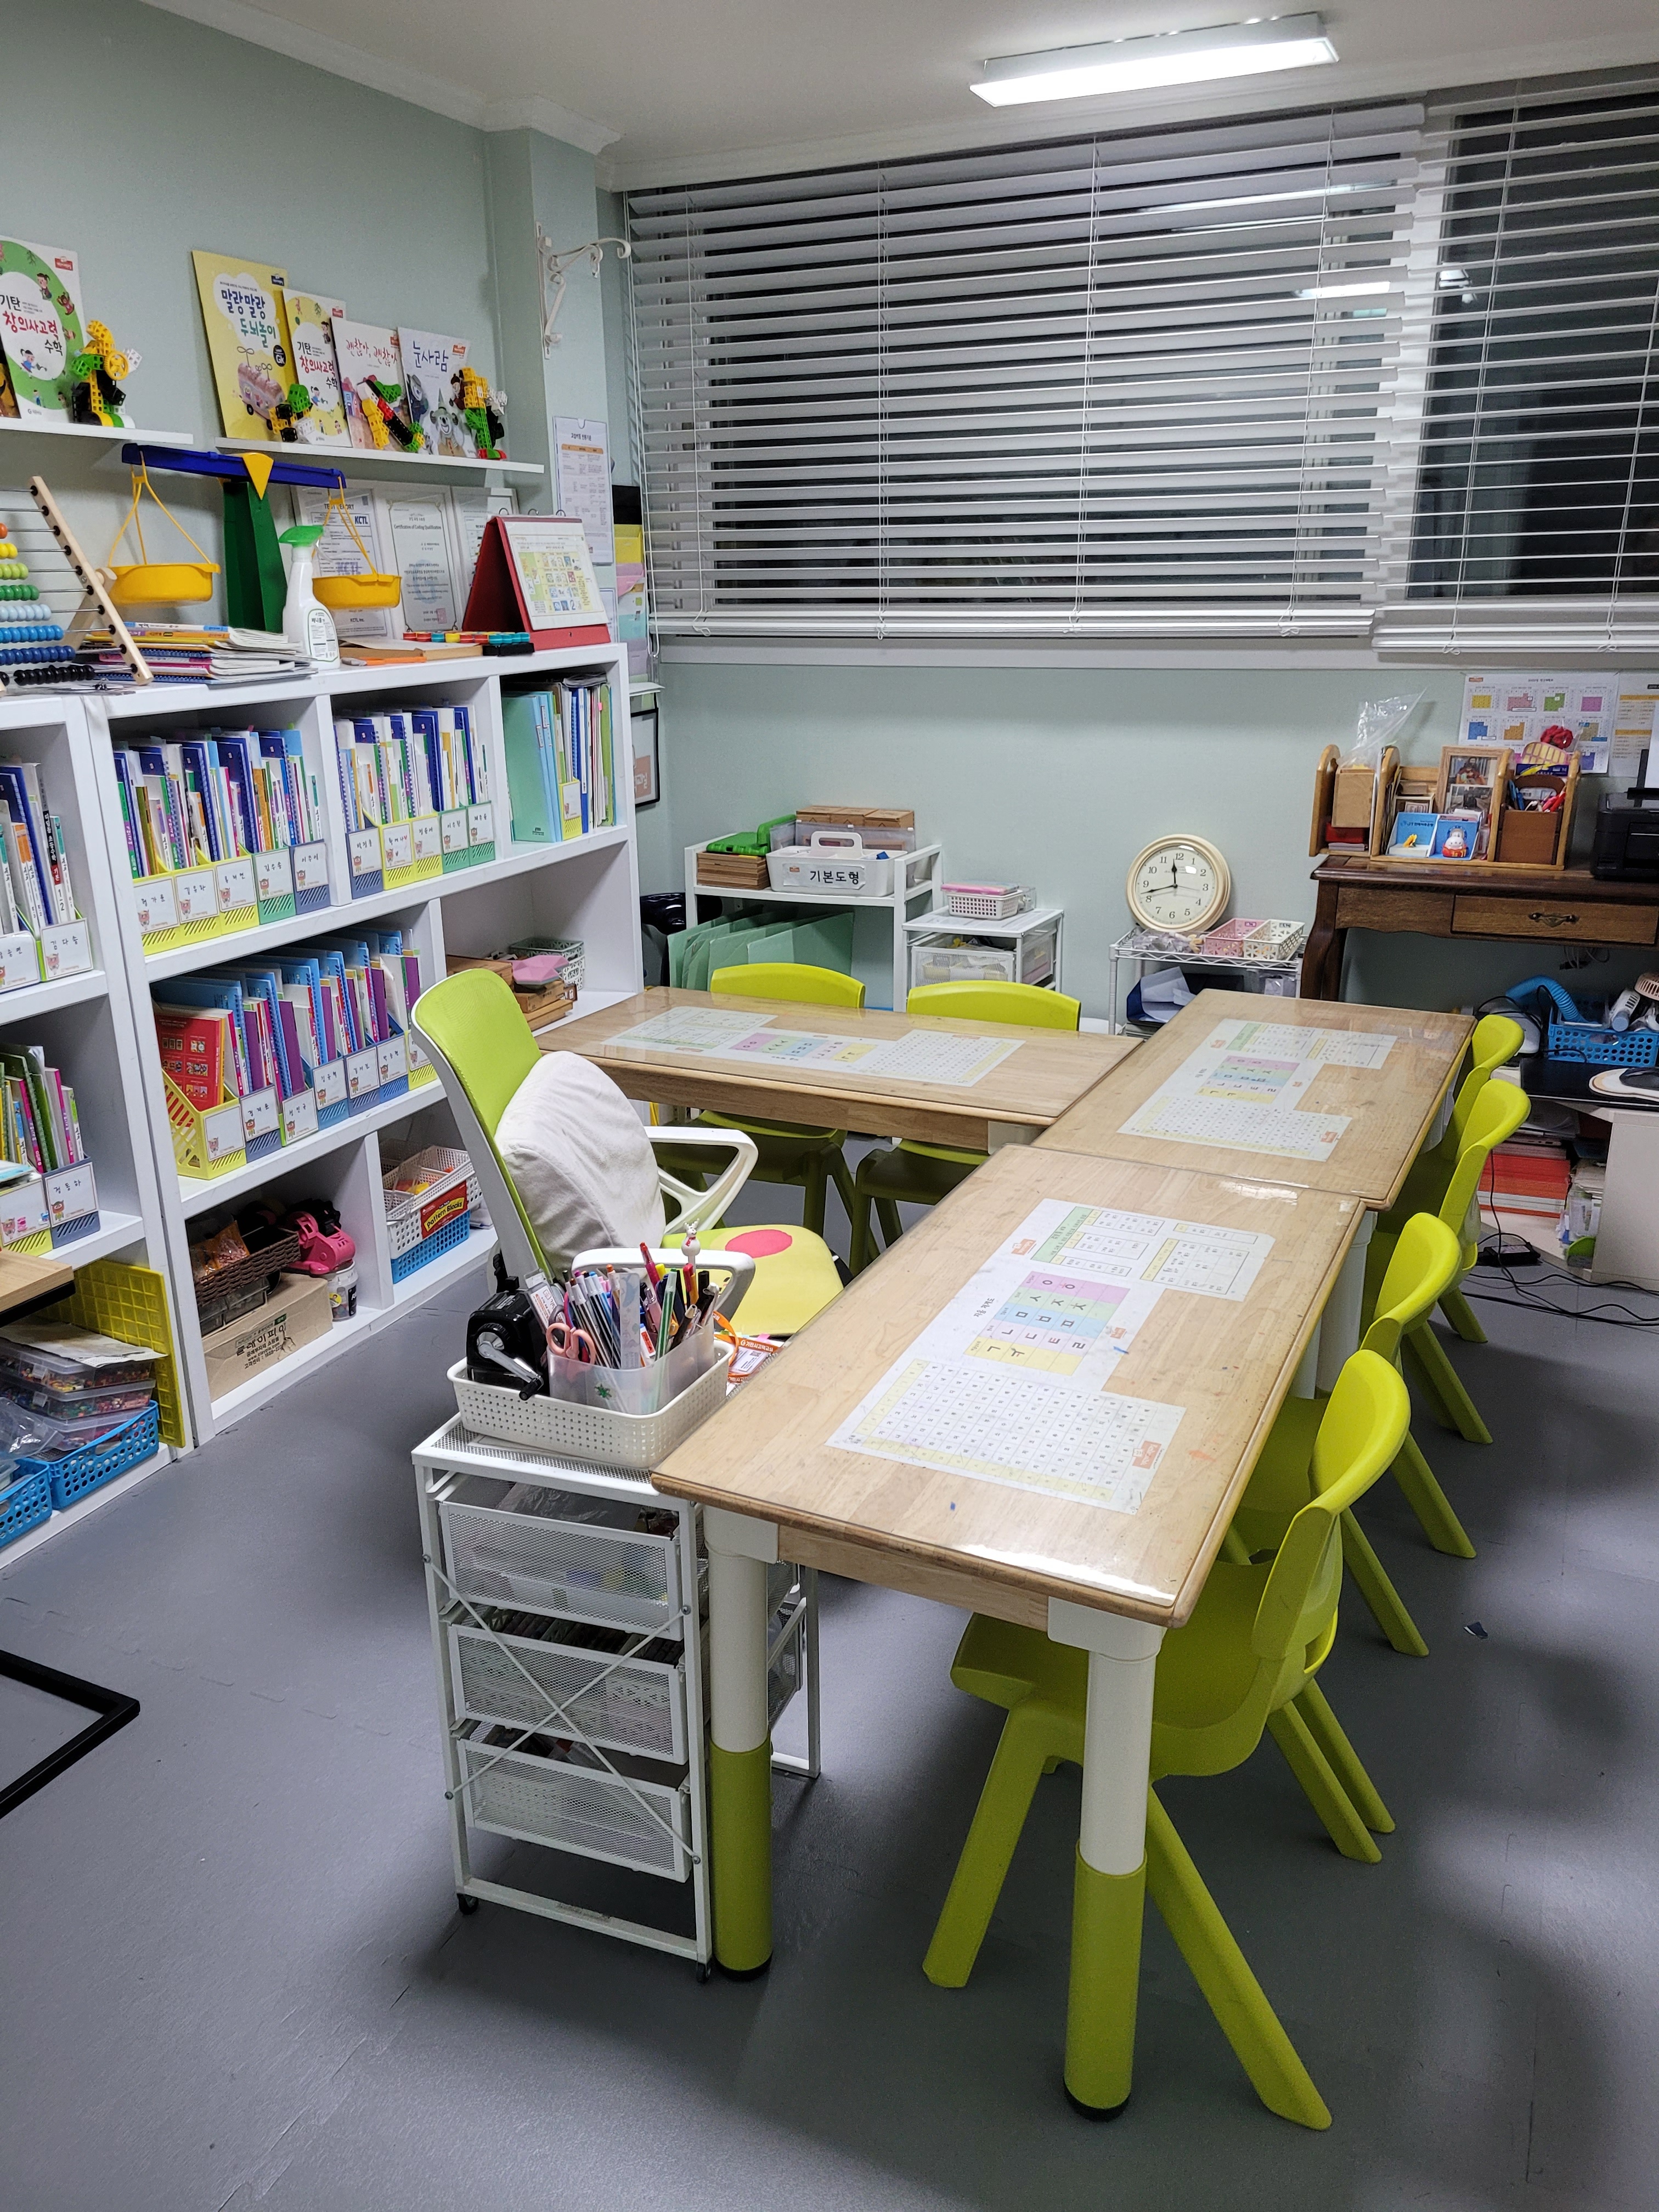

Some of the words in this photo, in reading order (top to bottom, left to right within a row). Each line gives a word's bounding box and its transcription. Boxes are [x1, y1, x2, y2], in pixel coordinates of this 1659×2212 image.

[0, 295, 21, 312] 기탄
[221, 289, 266, 319] 말랑말랑
[3, 311, 59, 341] 창의사고력
[240, 318, 276, 348] 두뇌놀이
[44, 339, 63, 356] 수학
[297, 341, 312, 356] 기탄
[413, 341, 449, 373] 눈사람
[299, 356, 335, 377] 창의사고력
[326, 377, 338, 390] 수학
[354, 516, 368, 524] KCTL
[810, 870, 859, 885] 기본도형
[1202, 883, 1209, 891] 3
[426, 1209, 446, 1228] Pattern
[447, 1201, 462, 1212] Blocks
[747, 1341, 774, 1352] 기탄사고력교실
